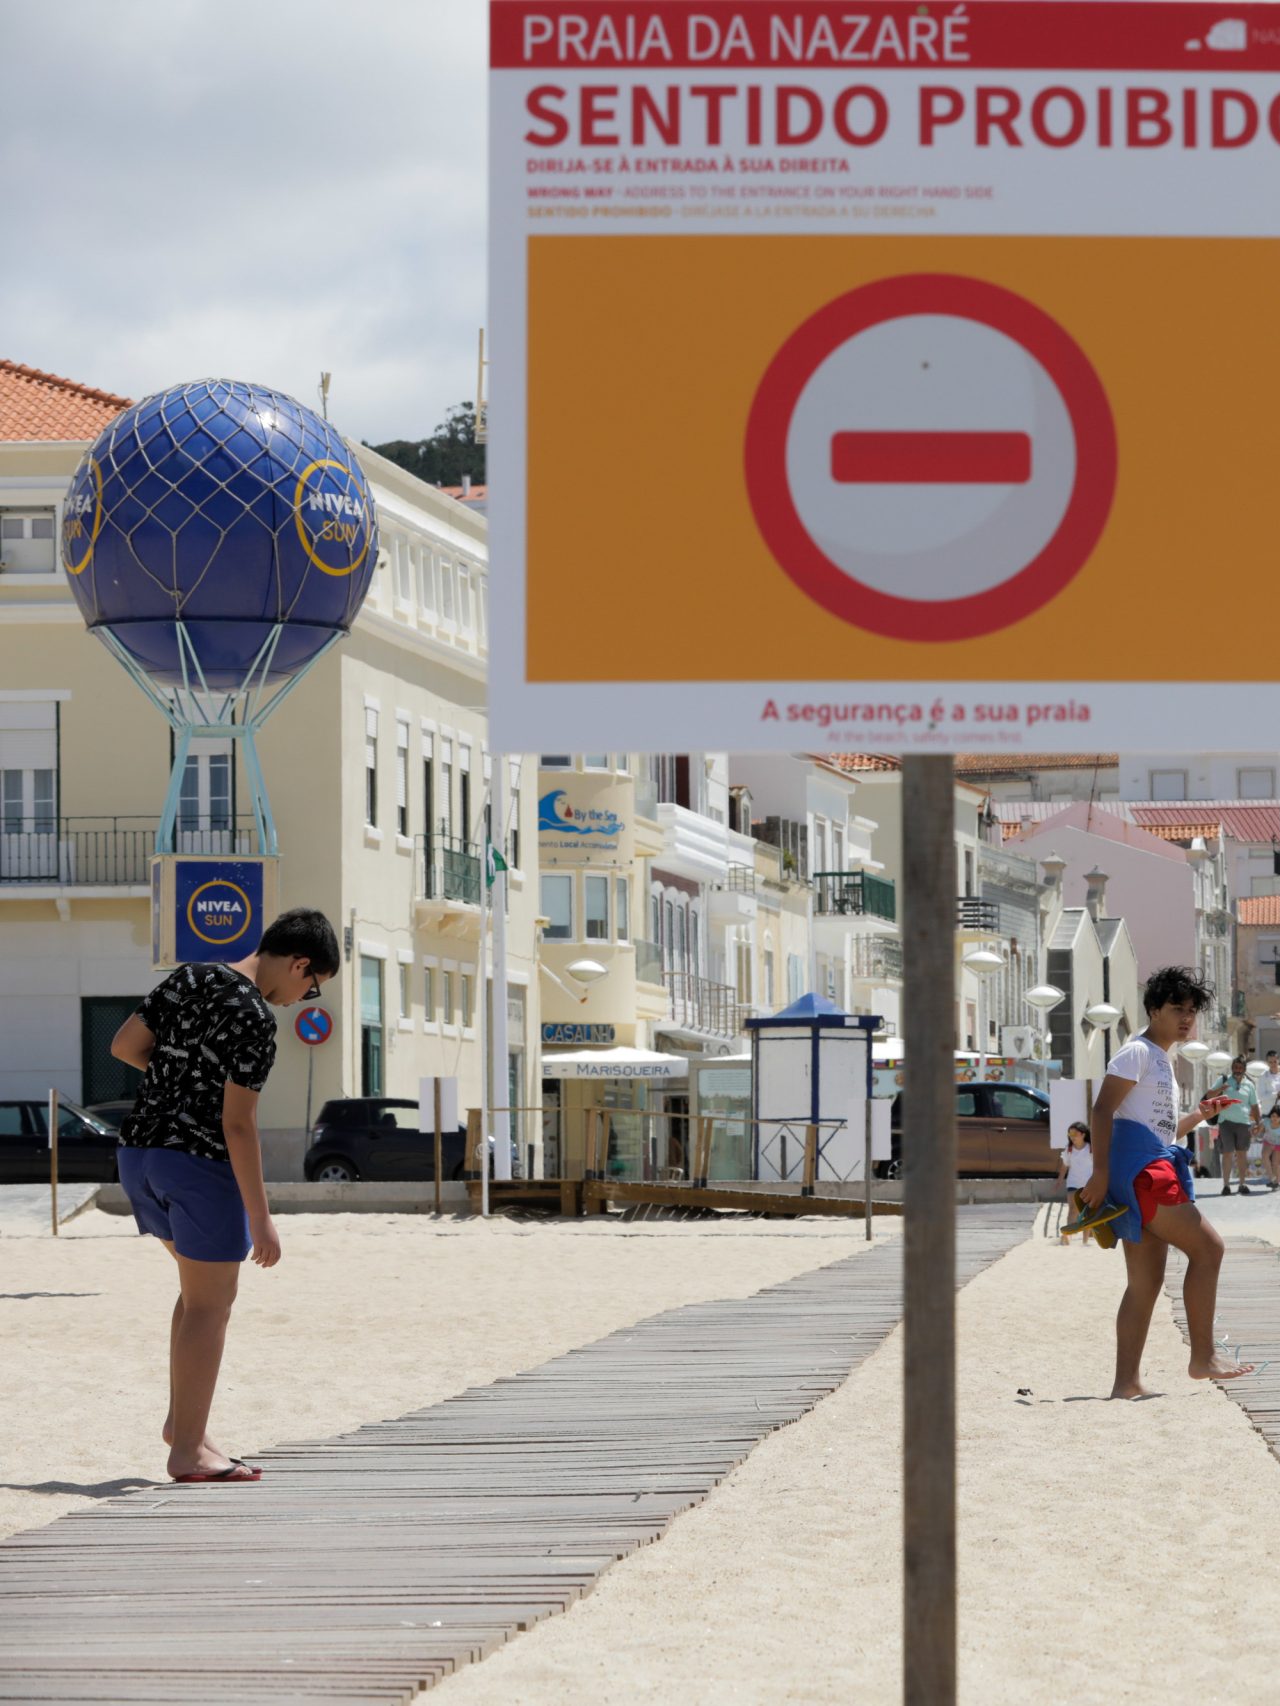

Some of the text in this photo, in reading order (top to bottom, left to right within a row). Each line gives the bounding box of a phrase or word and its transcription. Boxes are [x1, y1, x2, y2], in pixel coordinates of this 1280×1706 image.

[523, 4, 970, 61] PRAIA DA NAZARÉ
[523, 84, 890, 148] SENTIDO
[526, 154, 850, 173] DIRIJA-SE À ENTRADA À SUA DIREITA
[527, 187, 581, 198] WRONG
[584, 187, 613, 198] WAY
[624, 187, 685, 198] ADDRESS
[689, 187, 707, 198] TO
[710, 187, 736, 198] THE
[740, 187, 810, 198] ENTRANCE
[815, 187, 834, 198] ON
[838, 187, 875, 198] YOUR
[879, 187, 918, 198] RIGHT
[922, 187, 961, 198] HAND
[964, 187, 993, 198] SIDE
[309, 491, 364, 517] NIVEA
[323, 520, 356, 542] SUN
[761, 697, 1091, 728] A segurança é a sua praia
[574, 809, 617, 821] By the Sea
[197, 901, 242, 912] NIVEA
[204, 914, 232, 926] SUN
[543, 1024, 615, 1043] CASALINHO
